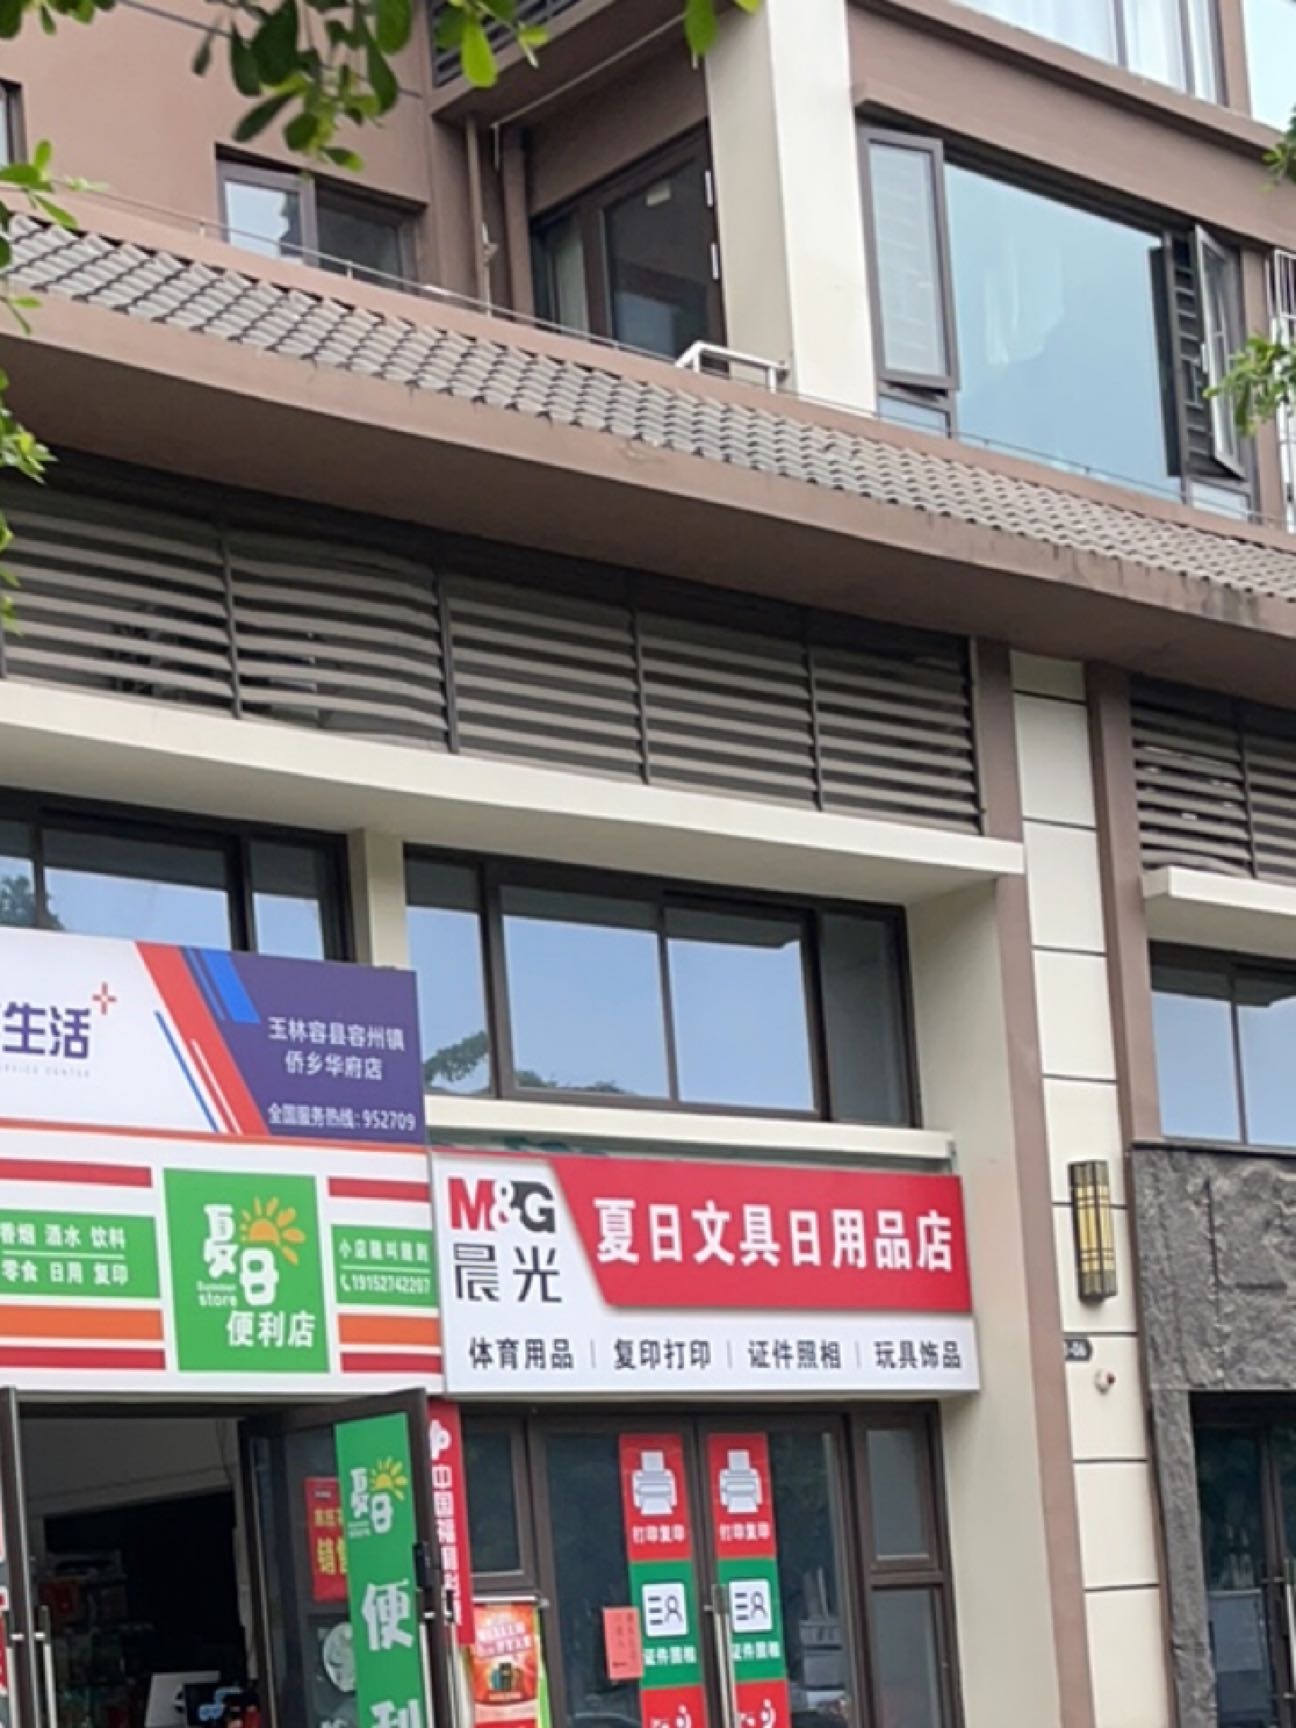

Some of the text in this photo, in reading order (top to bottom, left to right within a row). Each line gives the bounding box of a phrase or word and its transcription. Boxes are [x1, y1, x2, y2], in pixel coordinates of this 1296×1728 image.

[267, 1015, 405, 1051] 玉林容县容州镇
[285, 1050, 384, 1081] 侨乡华府店
[447, 1175, 556, 1234] M&G
[0, 1222, 127, 1250] 香烟 酒水 饮料
[593, 1198, 954, 1272] 夏日文具日用品店
[1, 1259, 129, 1287] 零食 日用 复印
[453, 1242, 563, 1304] 晨光
[226, 1310, 316, 1348] 便利店
[469, 1337, 963, 1370] 体育用品 复印打印 证件照相 玩具饰品
